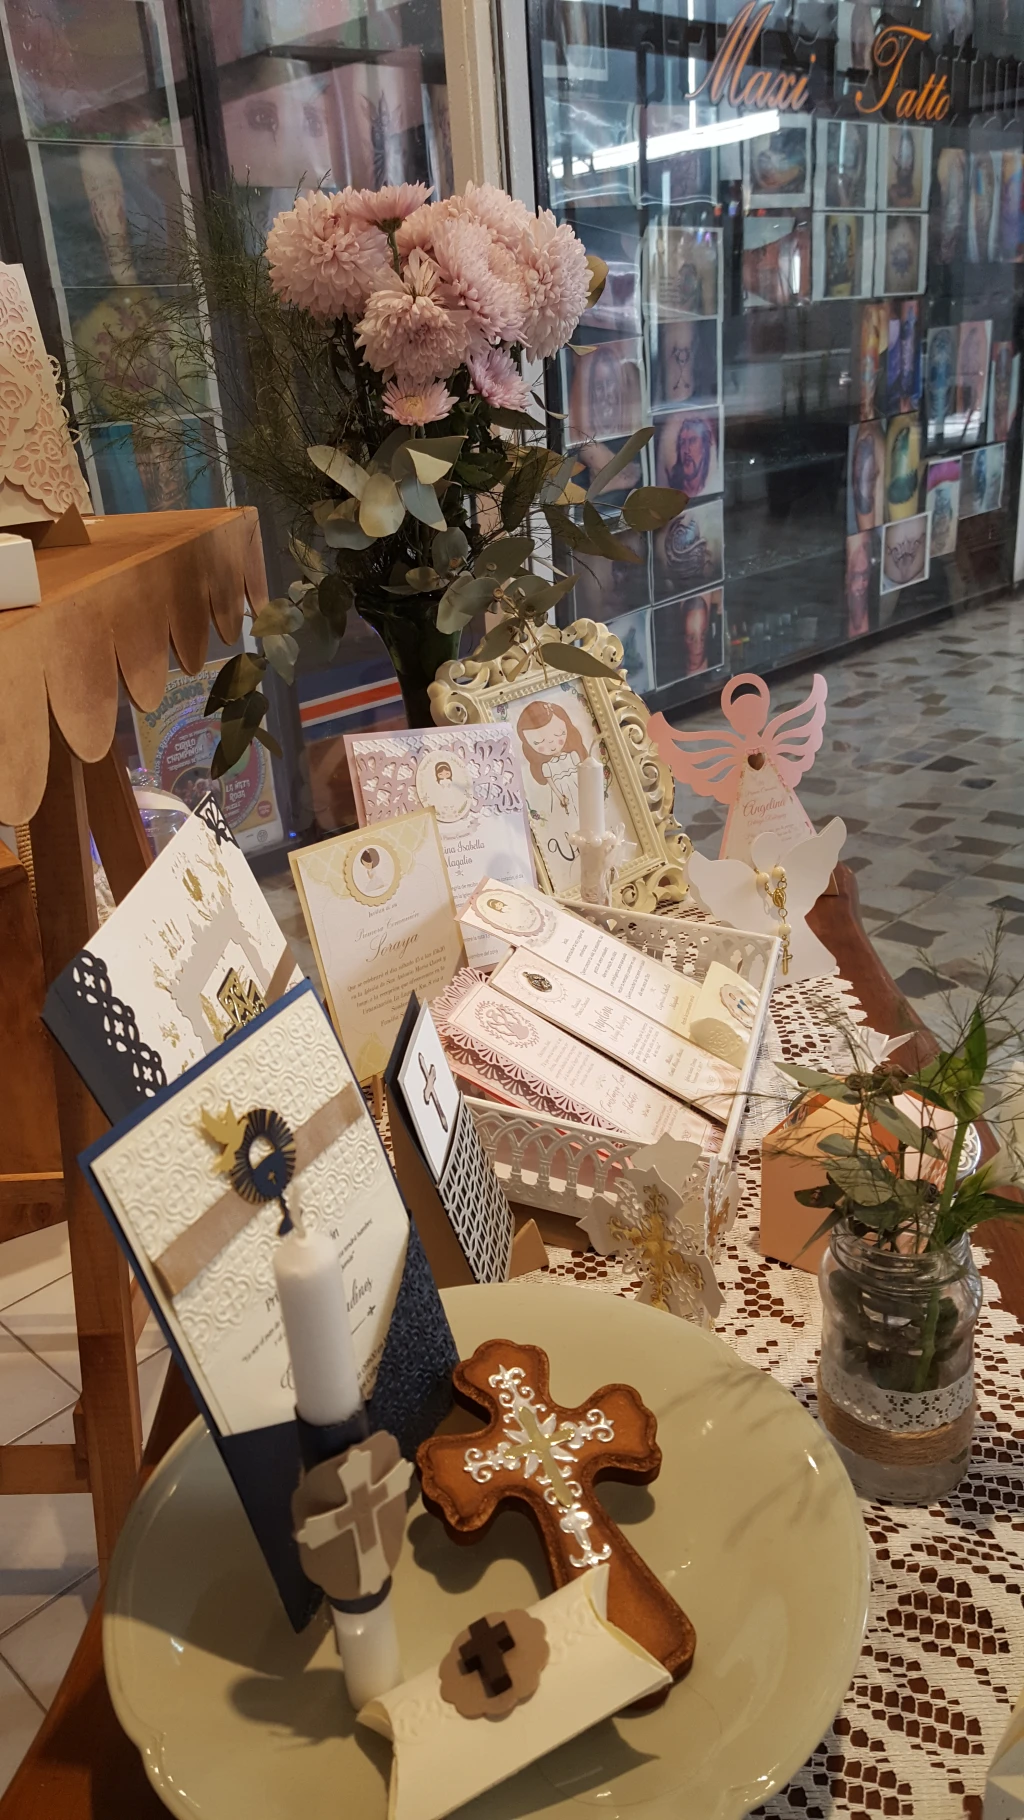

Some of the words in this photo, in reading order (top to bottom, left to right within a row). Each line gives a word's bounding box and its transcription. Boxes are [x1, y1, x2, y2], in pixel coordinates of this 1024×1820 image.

[685, 1, 819, 110] Maxi
[855, 25, 950, 121] Tatto
[742, 798, 786, 818] Angelina
[456, 839, 485, 854] Isabella
[366, 932, 418, 962] Soraya
